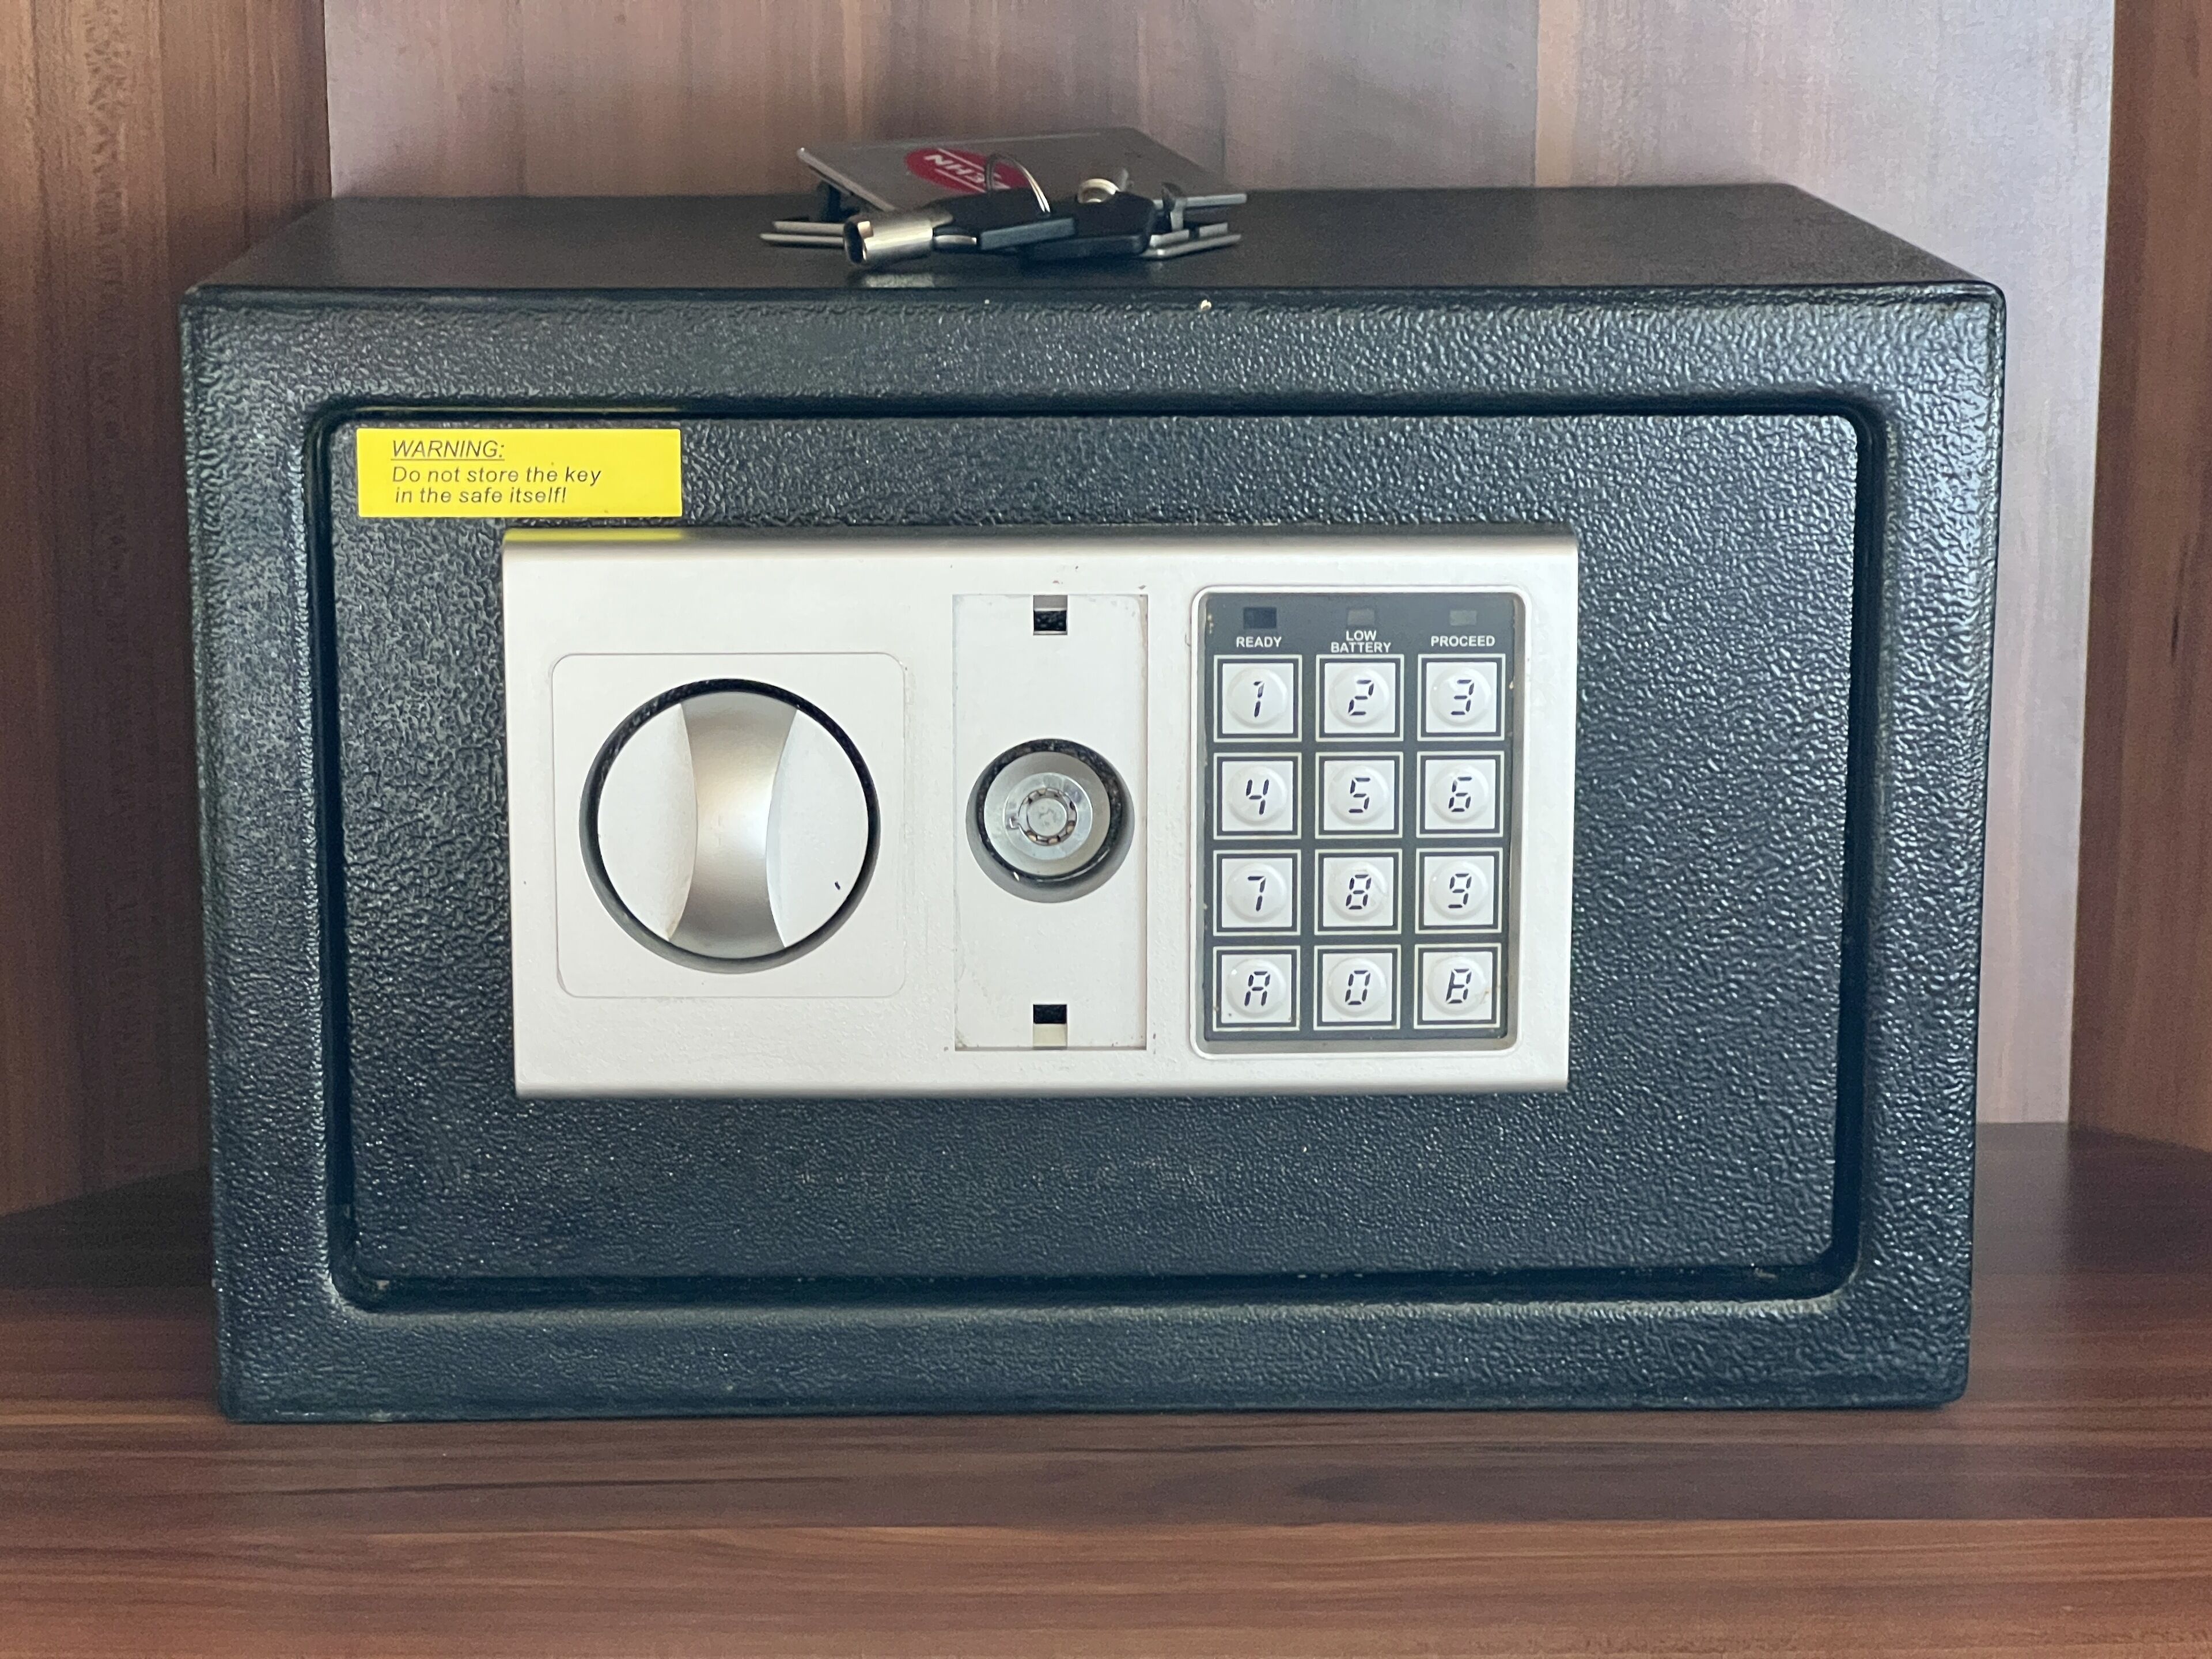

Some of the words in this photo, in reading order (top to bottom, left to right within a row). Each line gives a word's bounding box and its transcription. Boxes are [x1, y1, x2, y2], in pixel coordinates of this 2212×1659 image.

[393, 440, 505, 458] WARNING:
[393, 466, 421, 482] Do
[427, 467, 459, 482] not
[467, 467, 518, 482] store
[527, 467, 558, 482] the
[565, 467, 601, 486] key
[395, 487, 412, 503] in
[420, 487, 451, 503] the
[459, 487, 502, 503] safe
[510, 487, 566, 503] itself!
[1236, 636, 1282, 647] READY
[1331, 642, 1391, 653] BATTERY
[1346, 630, 1377, 641] LOW
[1431, 635, 1495, 647] PROCEED
[1253, 681, 1264, 718] 1
[1347, 679, 1374, 717] 2
[1450, 679, 1475, 716] 3
[1245, 779, 1270, 815] 4
[1348, 777, 1371, 813] 5
[1448, 777, 1472, 813] 6
[1247, 876, 1266, 912] 7
[1345, 874, 1372, 910] 8
[1448, 873, 1472, 909] 9
[1244, 971, 1271, 1007] A
[1344, 969, 1371, 1006] 0
